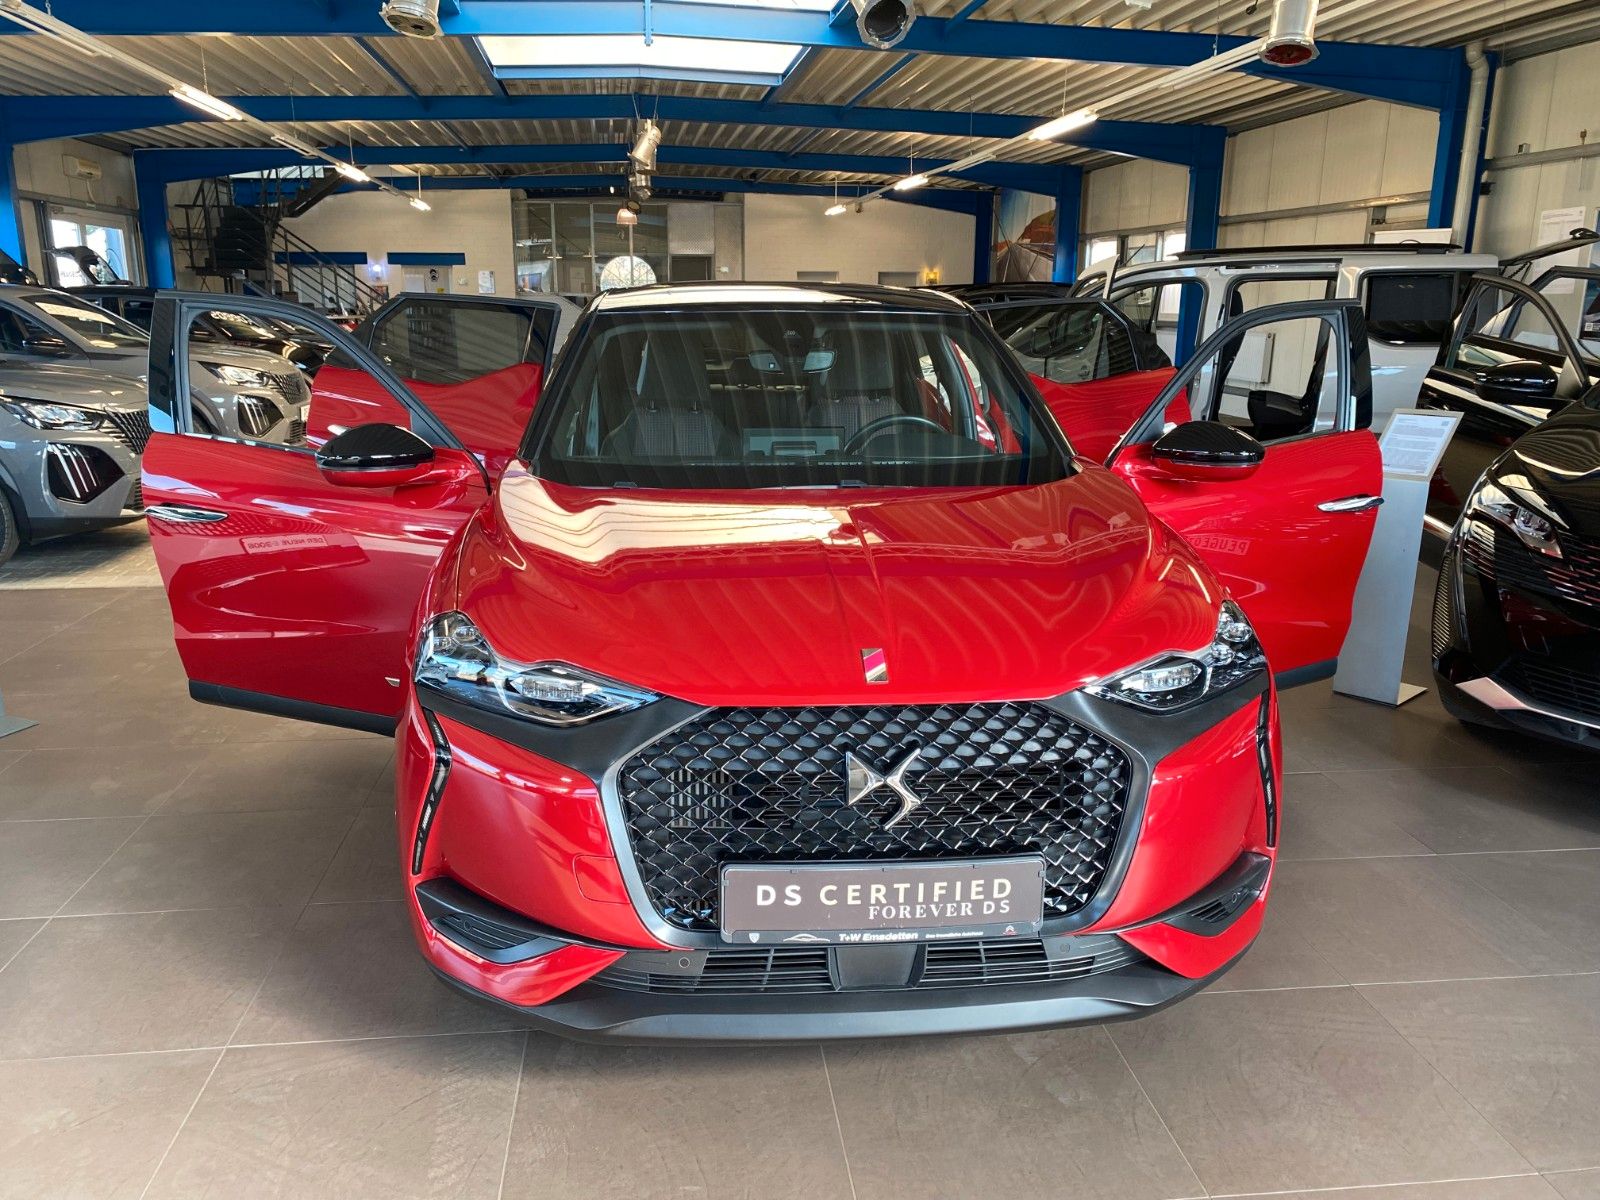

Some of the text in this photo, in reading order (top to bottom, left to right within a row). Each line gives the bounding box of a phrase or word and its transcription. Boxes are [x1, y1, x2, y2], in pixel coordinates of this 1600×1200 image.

[756, 878, 1012, 906] DS CERTIFIED
[868, 899, 1010, 920] FOREVER DS
